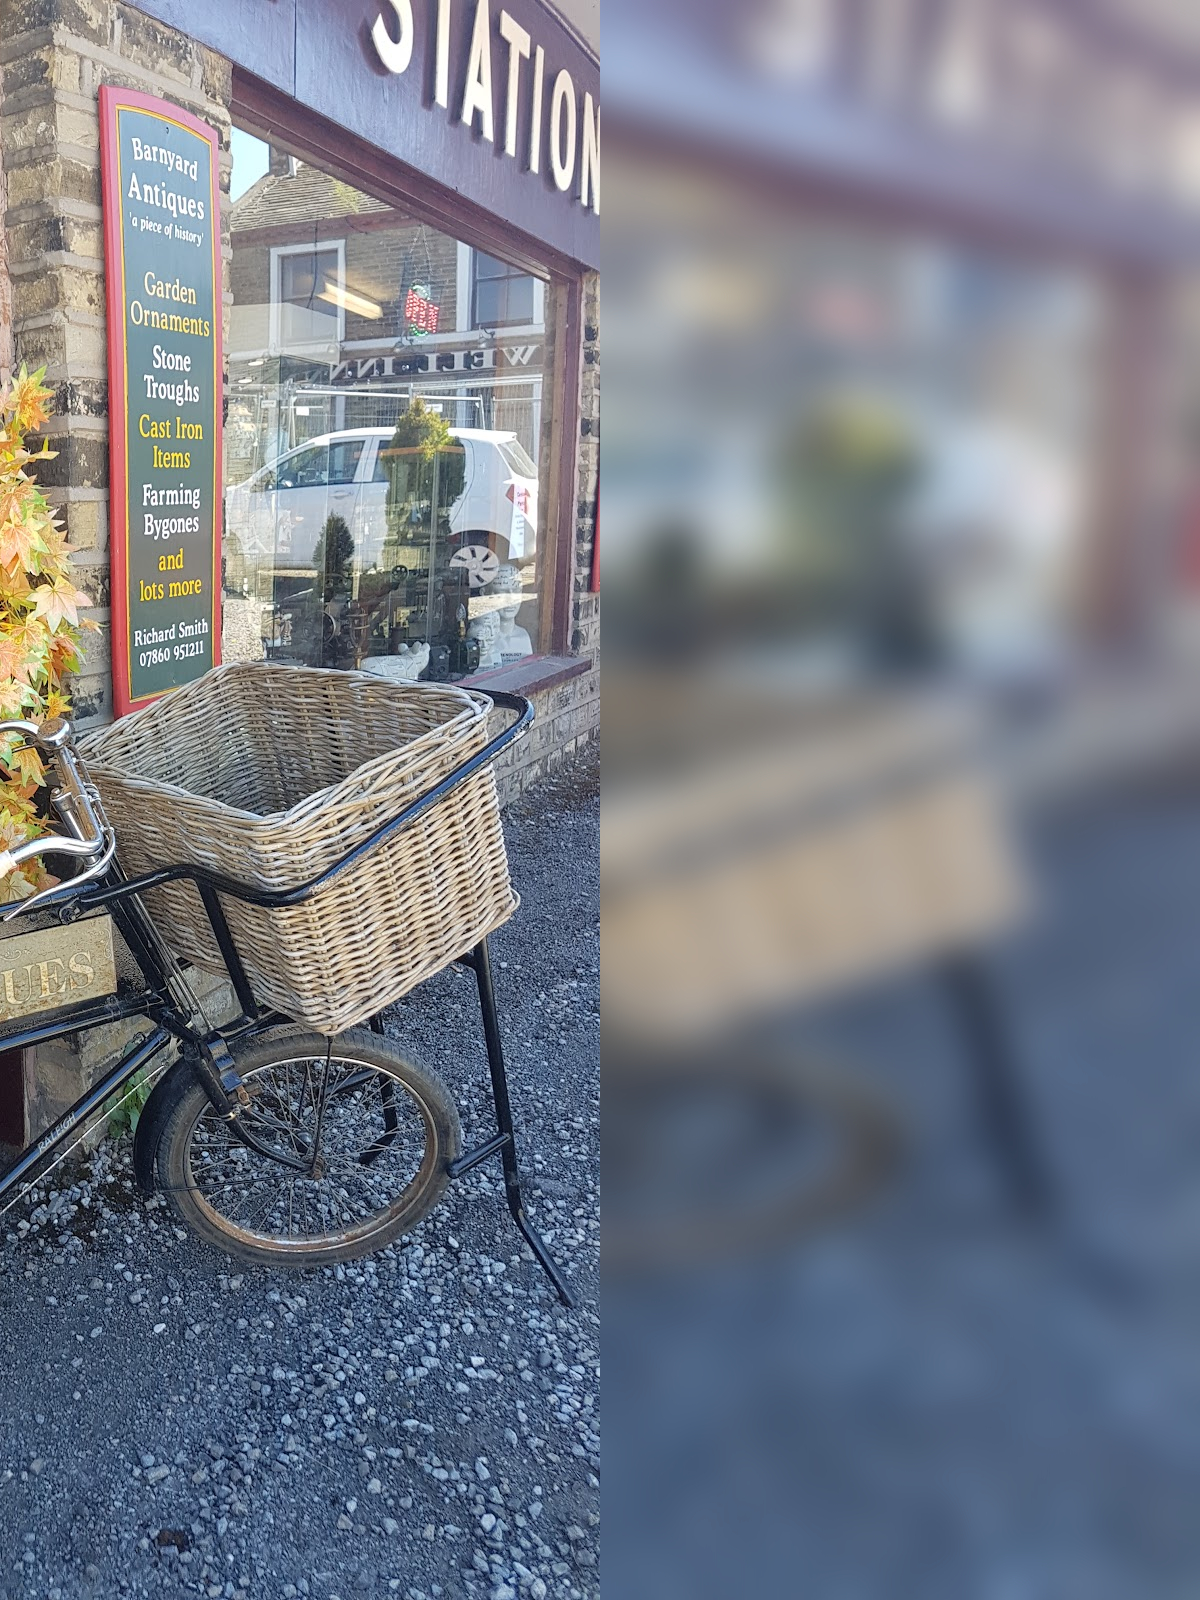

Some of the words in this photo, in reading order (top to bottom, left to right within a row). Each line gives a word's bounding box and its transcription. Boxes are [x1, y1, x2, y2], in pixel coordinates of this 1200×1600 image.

[131, 137, 198, 181] Barnyard
[128, 172, 205, 220] Antiques
[140, 216, 162, 234] piece
[164, 222, 173, 239] of
[144, 271, 197, 305] Garden
[130, 300, 210, 337] Ornaments
[405, 287, 440, 334] OPEN
[152, 344, 191, 372] Stone
[143, 374, 200, 407] Troughs
[139, 413, 171, 439] Cast
[175, 416, 204, 440] Iron
[152, 445, 191, 469] Items
[142, 482, 201, 510] Farming
[143, 513, 199, 541] Bygones
[158, 547, 184, 572] and
[139, 579, 164, 602] lots
[168, 578, 202, 598] more
[134, 623, 176, 647] Richard
[178, 617, 209, 639] Smith
[139, 647, 171, 668] 07860
[173, 640, 204, 661] 951211
[37, 1110, 76, 1152] RALEIGH
